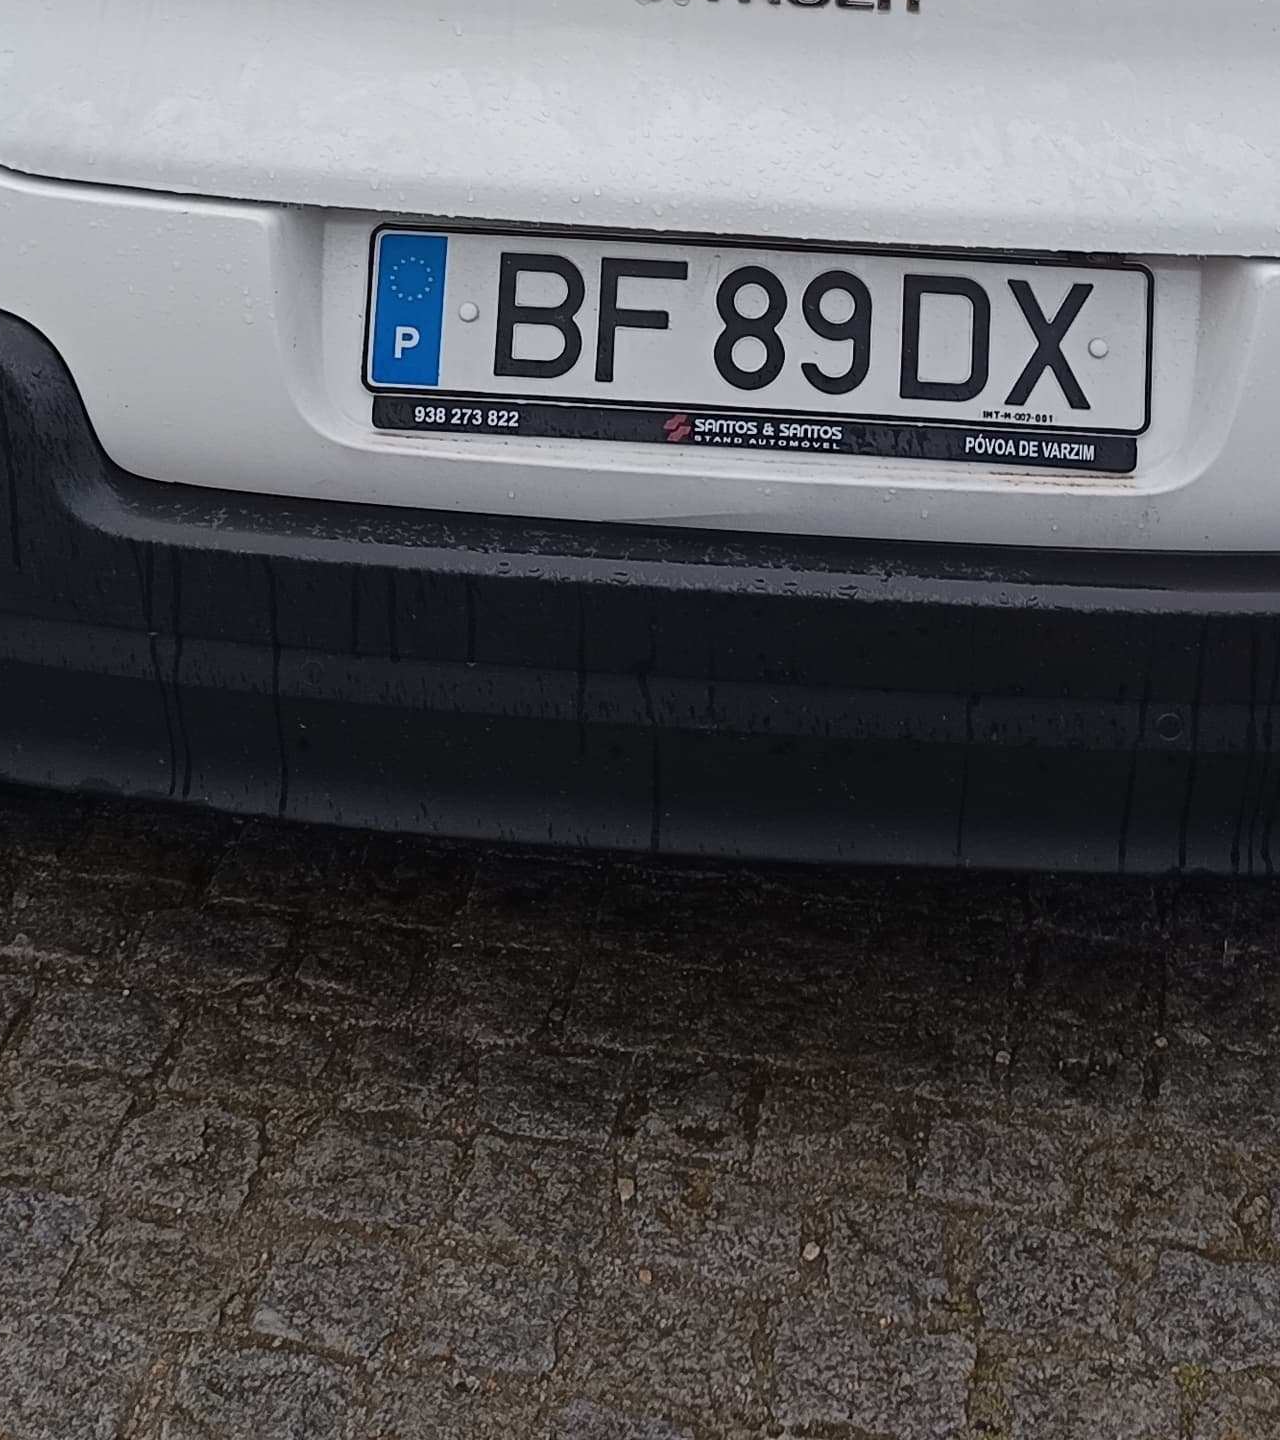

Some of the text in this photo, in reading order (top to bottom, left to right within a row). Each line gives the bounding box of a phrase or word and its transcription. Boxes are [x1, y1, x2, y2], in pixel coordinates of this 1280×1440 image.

[493, 251, 1094, 410] BF 89 DX
[394, 327, 420, 359] P
[414, 406, 519, 427] 938 273 822
[694, 419, 842, 440] SANTOS & SANTOS
[694, 435, 742, 445] STAND
[965, 433, 1095, 461] PÓVOA DE VARZIM
